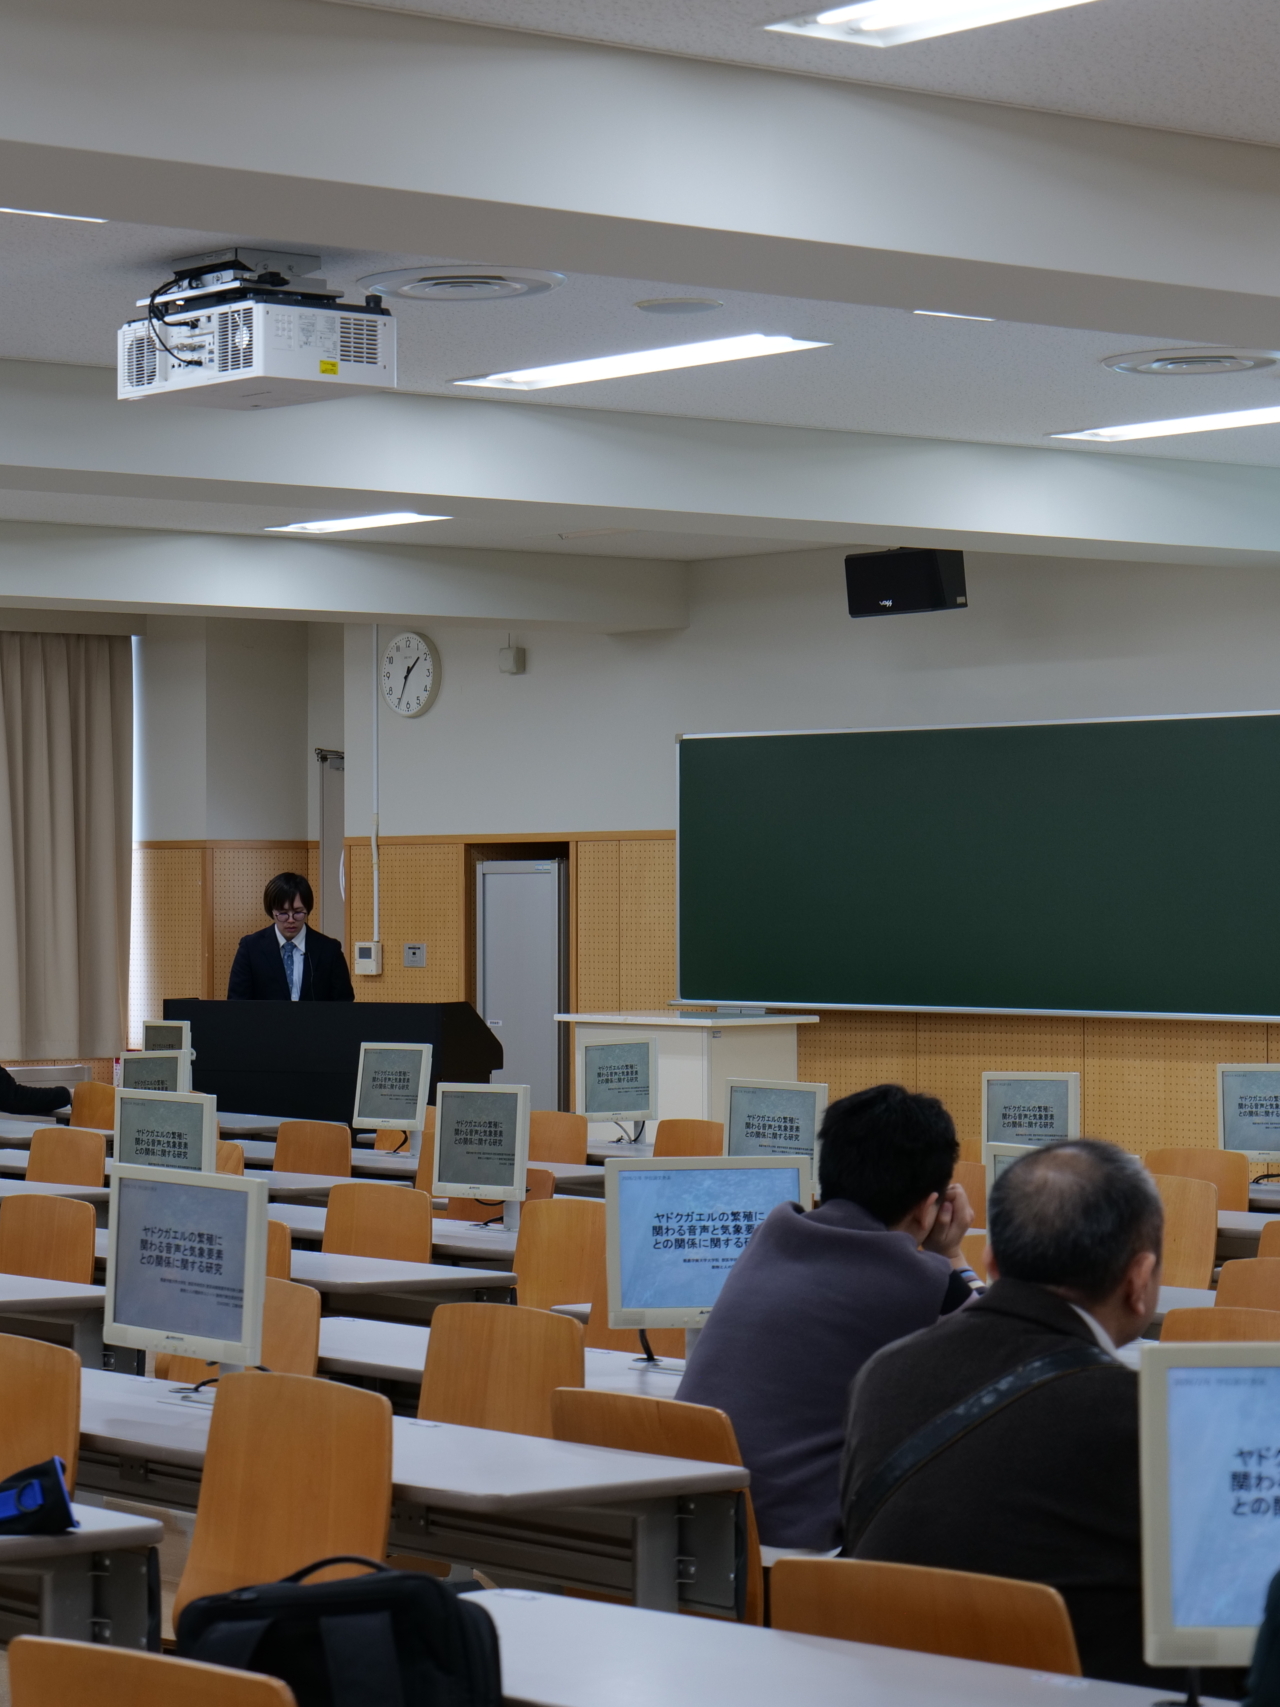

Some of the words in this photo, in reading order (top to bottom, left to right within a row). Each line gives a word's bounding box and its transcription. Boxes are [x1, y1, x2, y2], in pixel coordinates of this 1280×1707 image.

[654, 1211, 765, 1222] ヤドクガエルの繁殖に
[142, 1225, 223, 1246] ヤドクガエルの繁殖に
[652, 1224, 757, 1236] 関わる音声と気象要
[140, 1238, 224, 1261] 関わる音声と気象要素
[652, 1237, 750, 1249] との関係に関する
[140, 1254, 223, 1275] との関係に関する研究
[1231, 1471, 1280, 1492] 関わ
